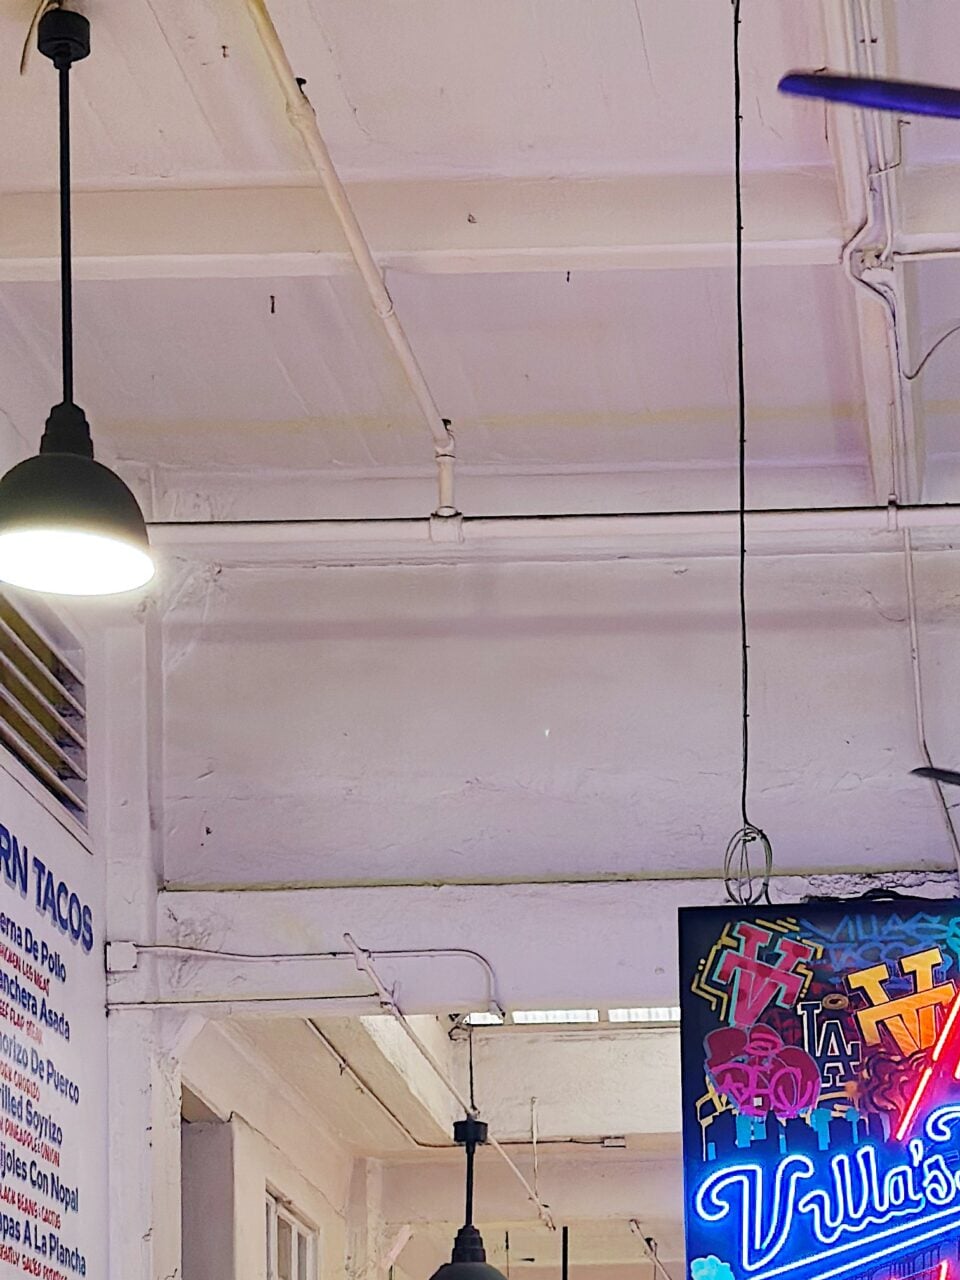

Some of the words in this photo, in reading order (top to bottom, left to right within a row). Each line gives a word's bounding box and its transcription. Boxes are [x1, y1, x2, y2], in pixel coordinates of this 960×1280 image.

[33, 856, 94, 952] TACOS
[25, 927, 39, 961] De
[41, 941, 66, 983] Pollo
[40, 997, 70, 1042] Asada
[31, 1046, 44, 1080] De
[46, 1058, 79, 1105] Puerco
[26, 1098, 62, 1146] Soyrizo
[30, 1159, 48, 1196] Con
[50, 1171, 78, 1212] Nopal
[697, 1140, 958, 1270] Villa's
[23, 1219, 31, 1248] A
[34, 1224, 46, 1256] La
[49, 1232, 86, 1277] Plancha
